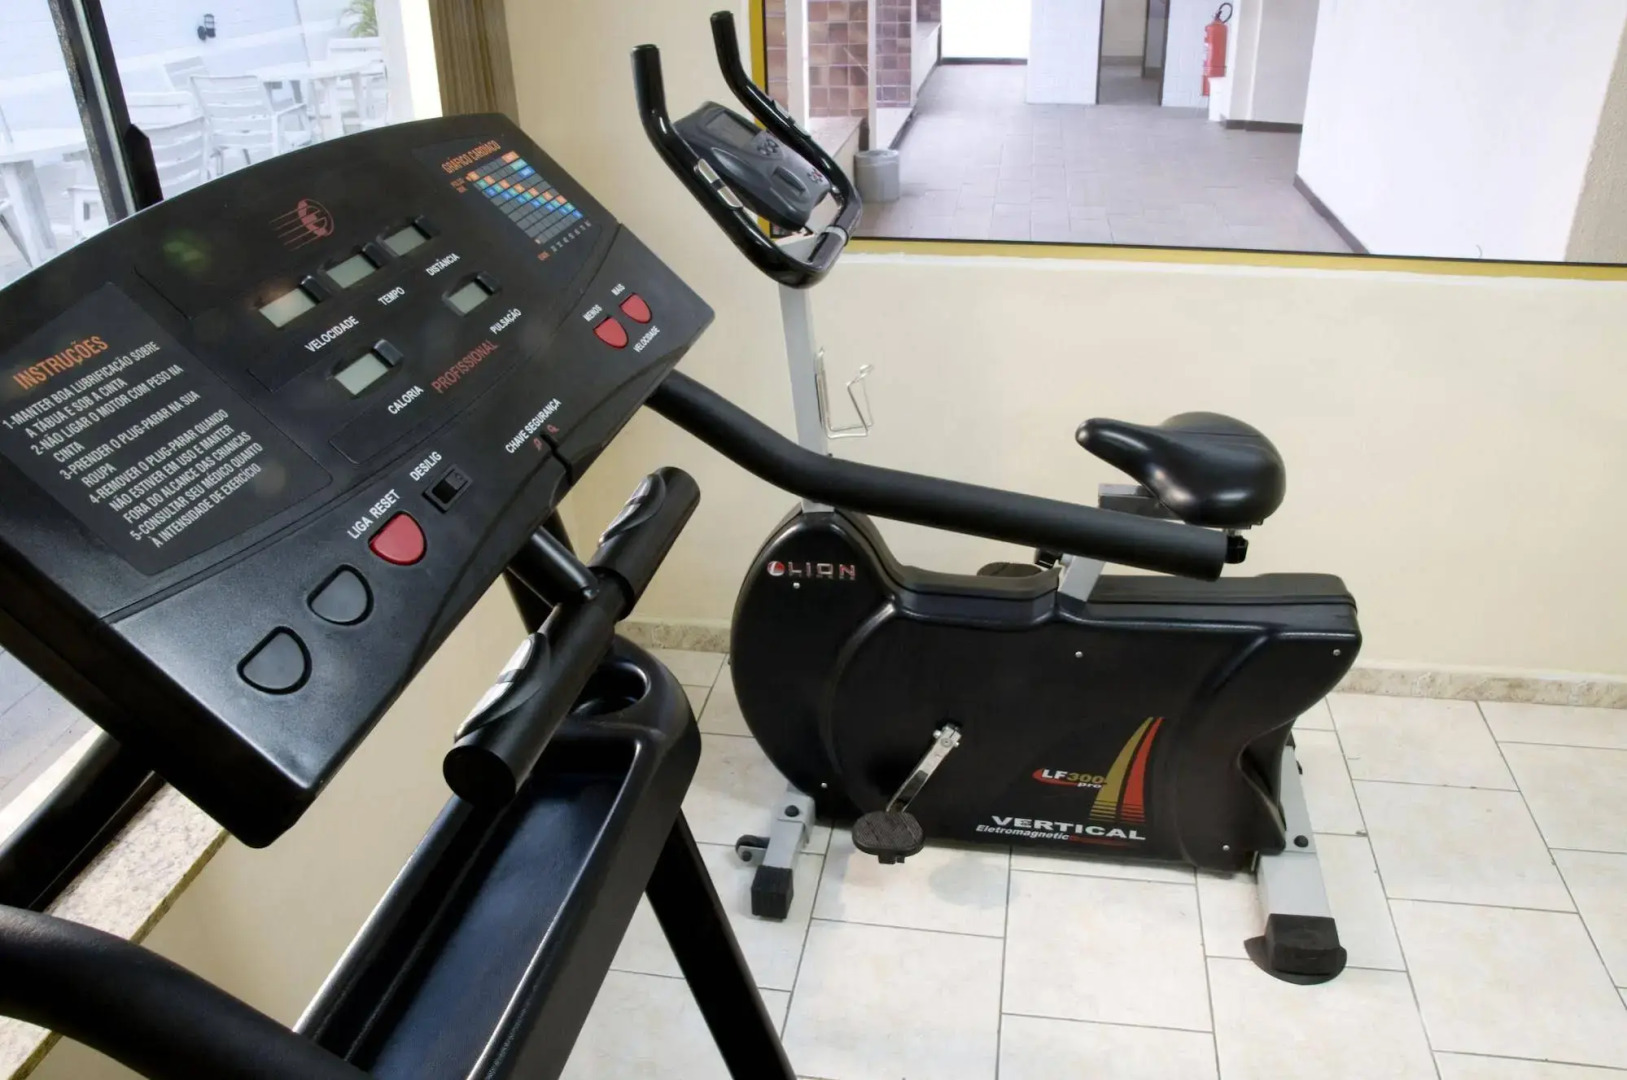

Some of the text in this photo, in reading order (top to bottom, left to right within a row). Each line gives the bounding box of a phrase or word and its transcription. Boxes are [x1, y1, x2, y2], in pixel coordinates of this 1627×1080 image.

[377, 286, 405, 306] TEMPO
[582, 304, 602, 322] MENOS
[611, 283, 625, 296] MAIS
[304, 315, 359, 352] VELOCIDADE
[489, 308, 522, 335] PULSAÇÃO
[633, 325, 660, 353] VELOCIDADE
[2, 341, 160, 430] 1-MANTER BOA LUBRIFICAÇÃO SOBRE
[13, 335, 108, 390] INSTRUÇÕES
[430, 339, 499, 394] PROFISSIONAL
[25, 377, 128, 439] A TÁBUA E SOB A CINTA
[30, 364, 184, 456] 2-NÃO LIGAR O MOTOR COM PESO NA
[387, 385, 424, 415] CALORIA
[59, 390, 201, 480] 3-PRENDER O PLUG-PARAR NA SUA
[505, 398, 562, 454] CHAVE SEGURANÇA
[53, 441, 85, 463] CINTA
[81, 462, 117, 488] ROUPA
[89, 408, 228, 503] 4-REMOVER O PLUG-PARAR QUANDO
[108, 424, 235, 512] NÃO ESTIVER EM USO E MANTER
[409, 451, 442, 482] DES/LIG
[122, 502, 151, 524] FORA
[146, 492, 164, 507] DO
[160, 467, 200, 498] ALCANCE
[195, 456, 216, 473] DAS
[129, 442, 263, 541] 5-CONSULTAR SEU MÉDICO QUANTO
[158, 498, 214, 542] INTENSIDADE
[208, 490, 226, 504] DE
[220, 463, 262, 496] EXERCÍCIO
[346, 488, 400, 539] LIGA RESET
[975, 824, 1070, 841] Eletromagnetic
[991, 815, 1146, 841] VERTICAL
